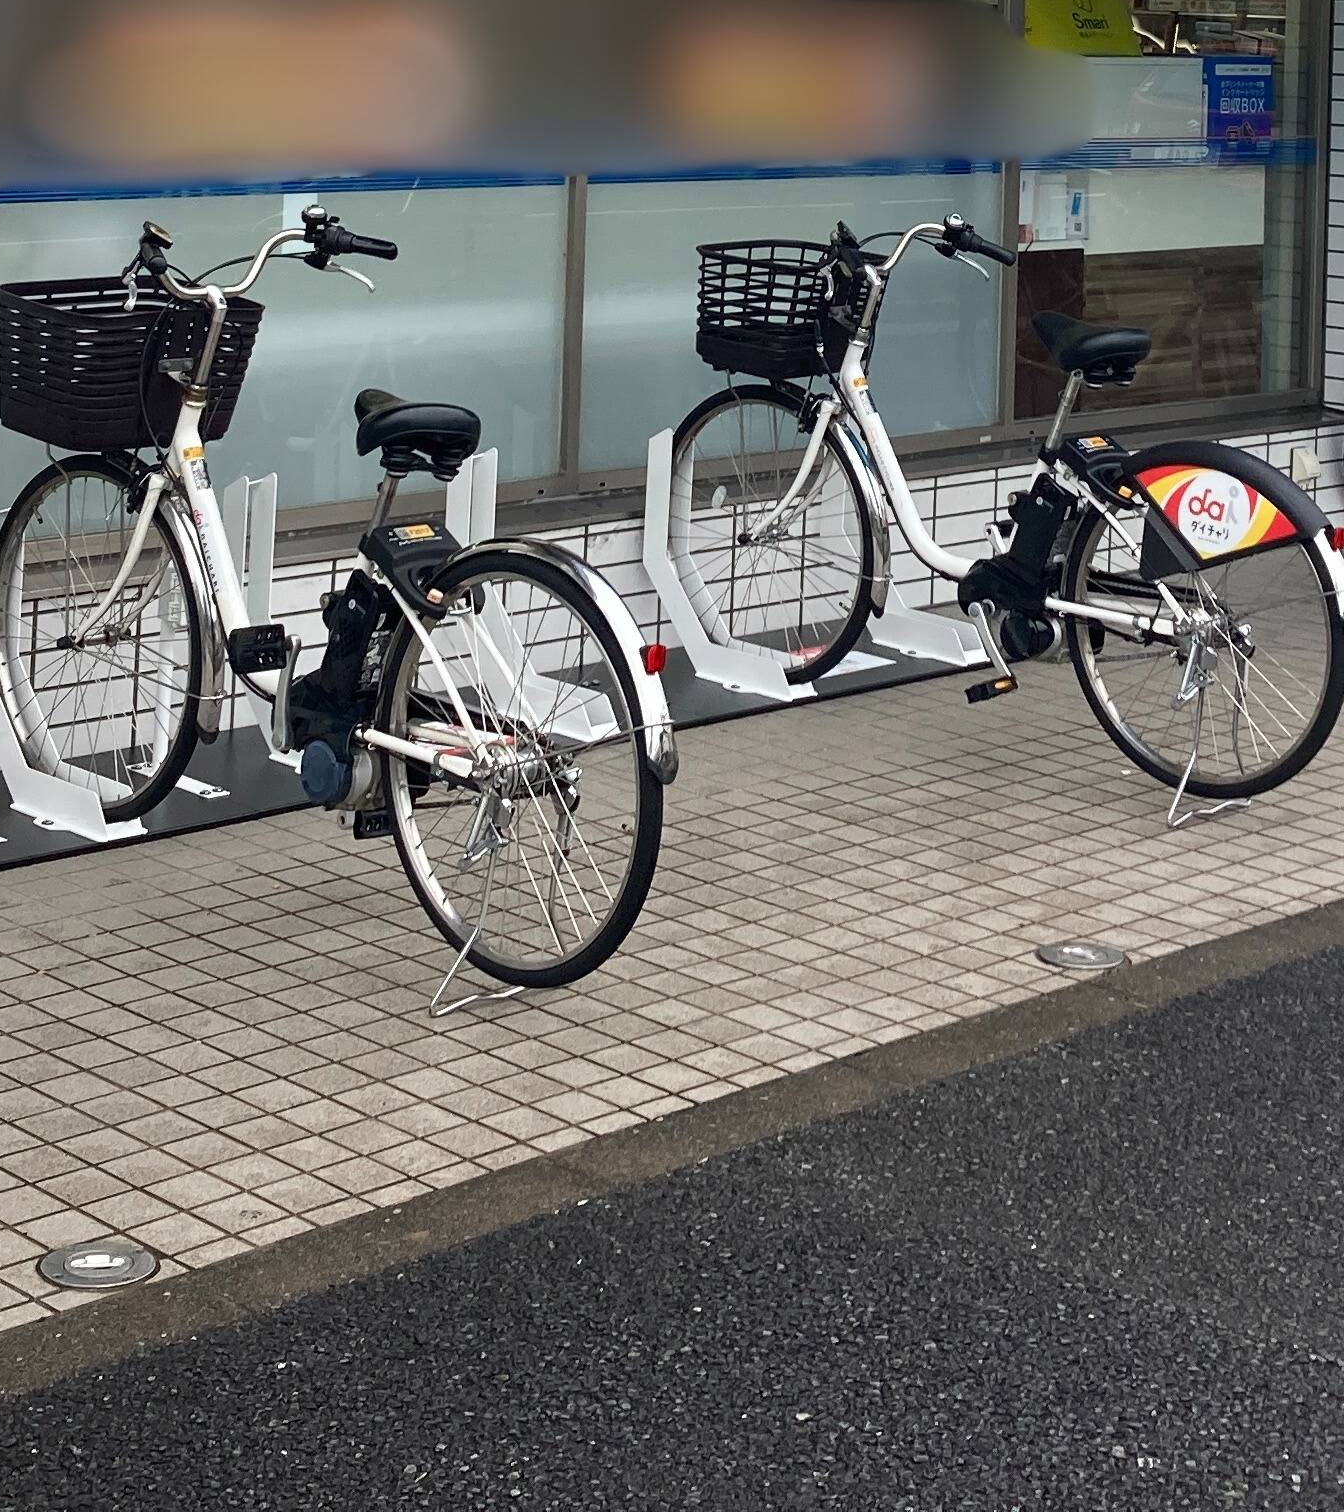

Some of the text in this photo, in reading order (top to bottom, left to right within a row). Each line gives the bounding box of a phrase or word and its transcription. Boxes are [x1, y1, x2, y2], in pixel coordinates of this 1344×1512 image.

[1072, 13, 1109, 29] Smari
[1220, 98, 1265, 113] 回収BOX
[1191, 520, 1230, 540] ダイチャリ
